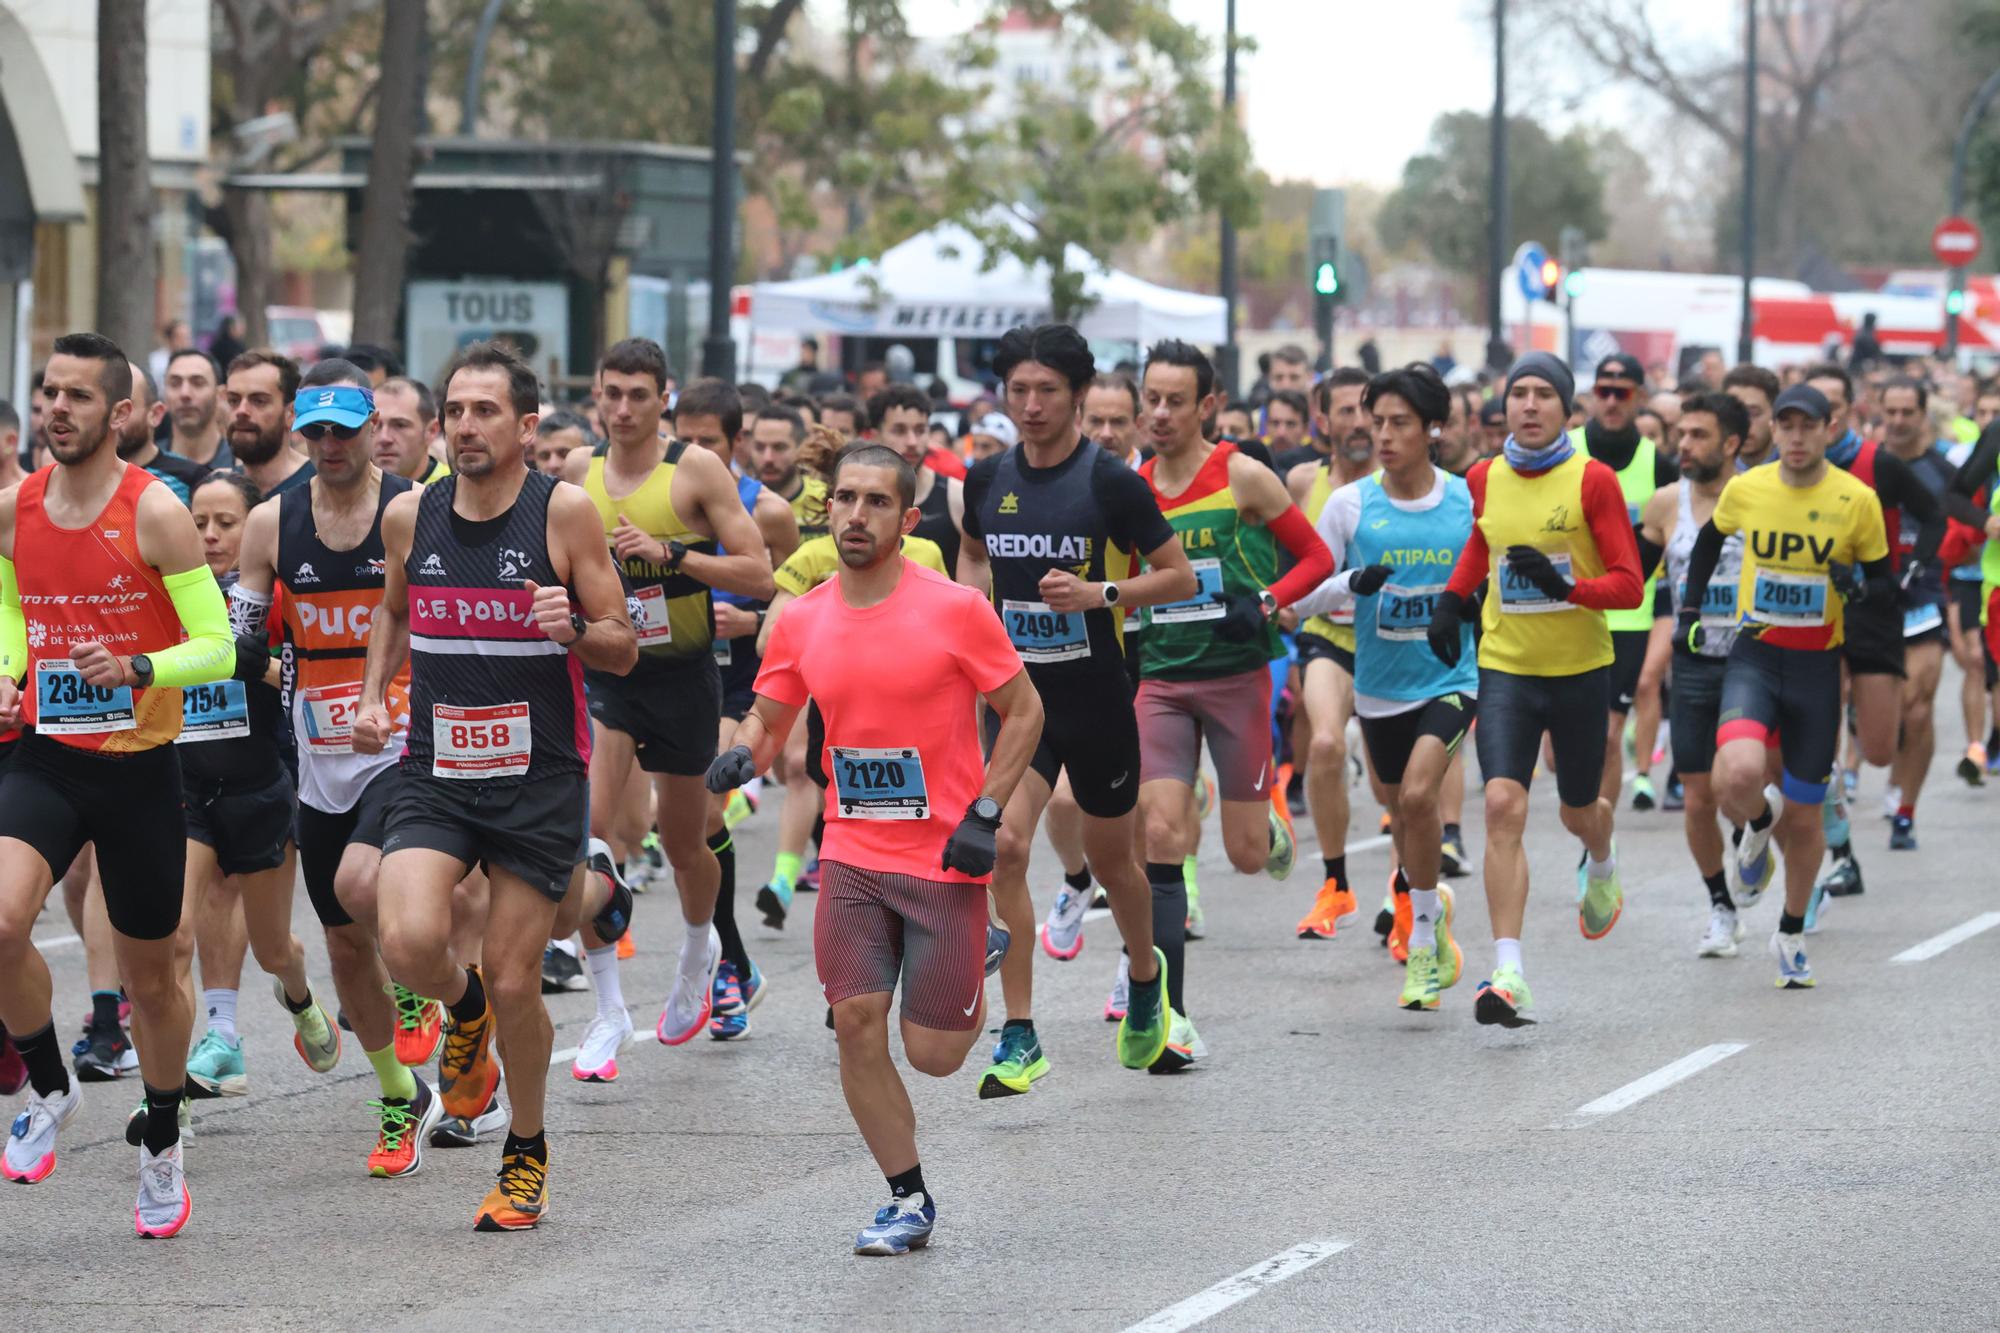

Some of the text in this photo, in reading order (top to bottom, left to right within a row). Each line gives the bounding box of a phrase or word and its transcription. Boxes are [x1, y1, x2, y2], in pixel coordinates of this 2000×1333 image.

[447, 292, 533, 323] TOUS
[985, 533, 1086, 560] REDOLAT
[1380, 549, 1453, 566] ATIPAQ
[1752, 530, 1835, 565] UPV
[1763, 581, 1812, 606] 2051
[416, 598, 452, 620] C.E.
[51, 624, 95, 633] LA CASA
[1013, 613, 1071, 638] 2494
[51, 632, 138, 645] DE LOS AROMAS
[451, 724, 510, 749] 858
[844, 761, 905, 788] 2120
